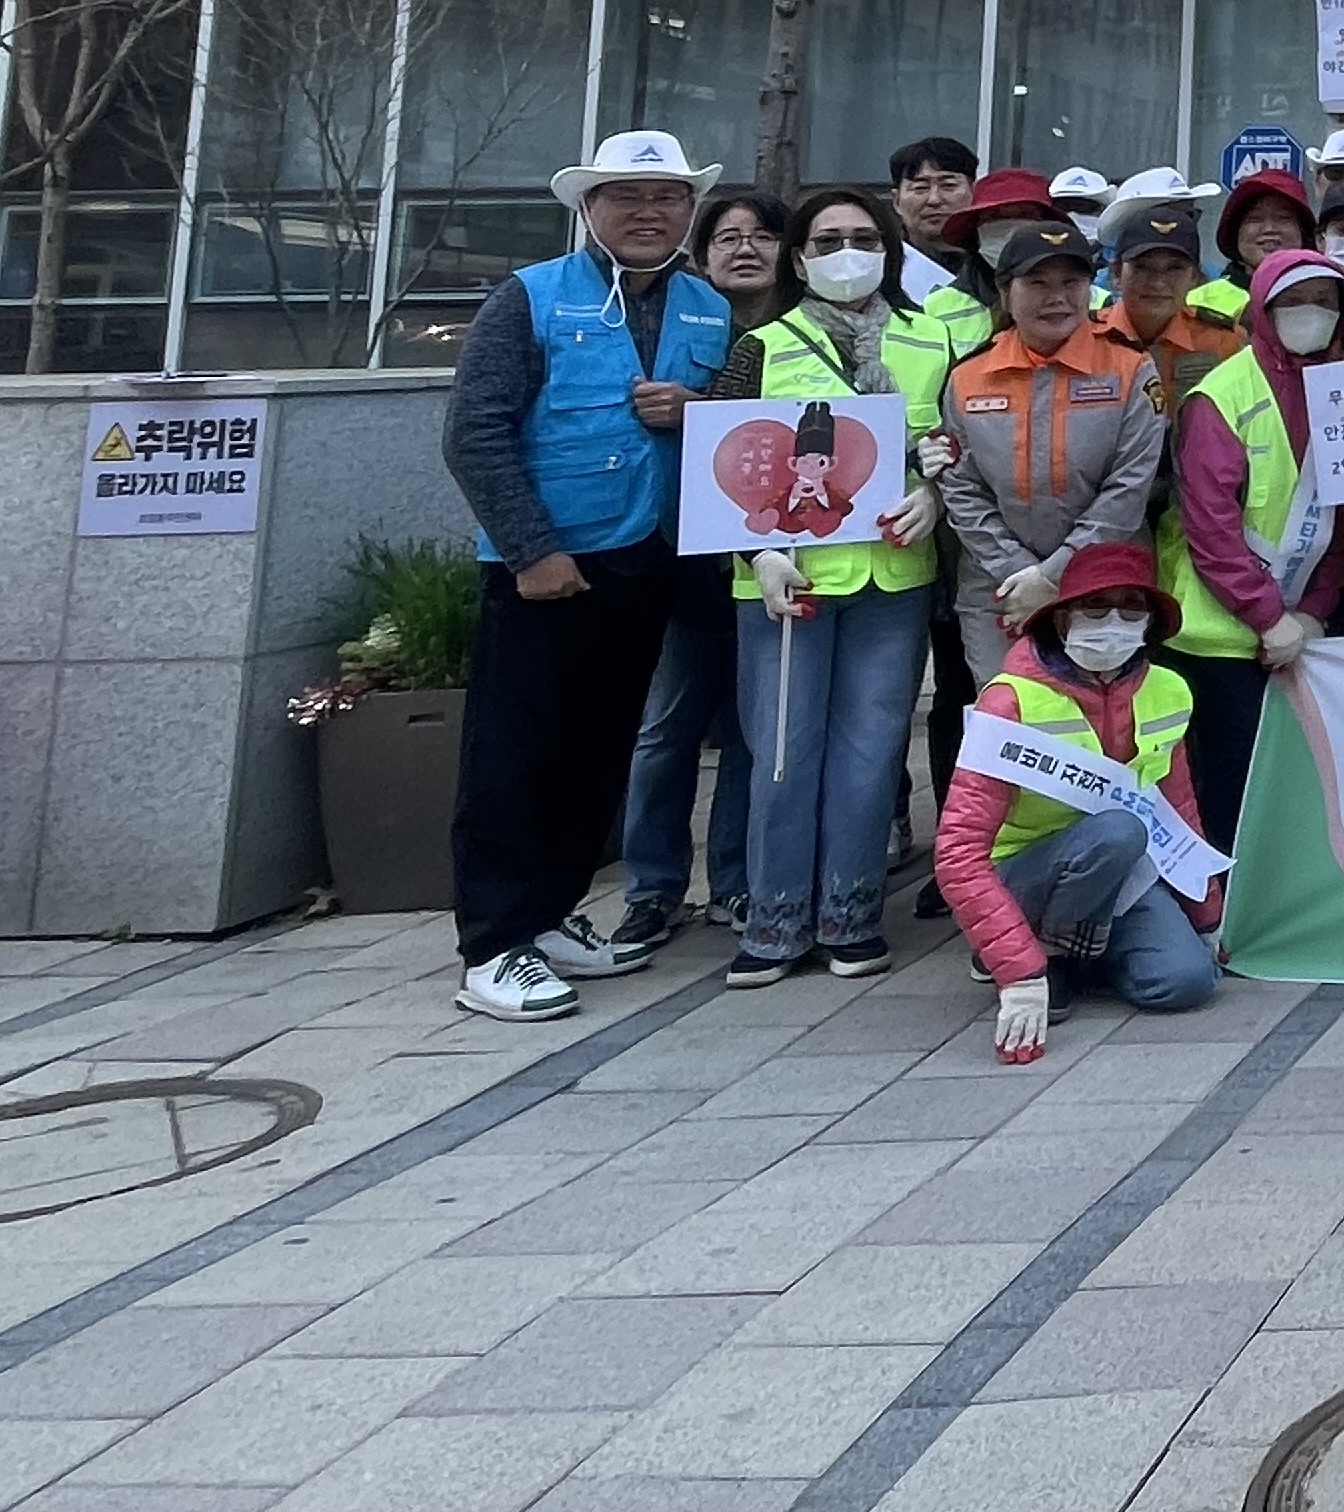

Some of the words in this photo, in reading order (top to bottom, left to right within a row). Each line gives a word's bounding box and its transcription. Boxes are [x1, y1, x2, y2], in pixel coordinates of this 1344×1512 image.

[134, 417, 259, 462] 추락위험
[95, 471, 179, 498] 올라가지
[184, 470, 246, 496] 마세요
